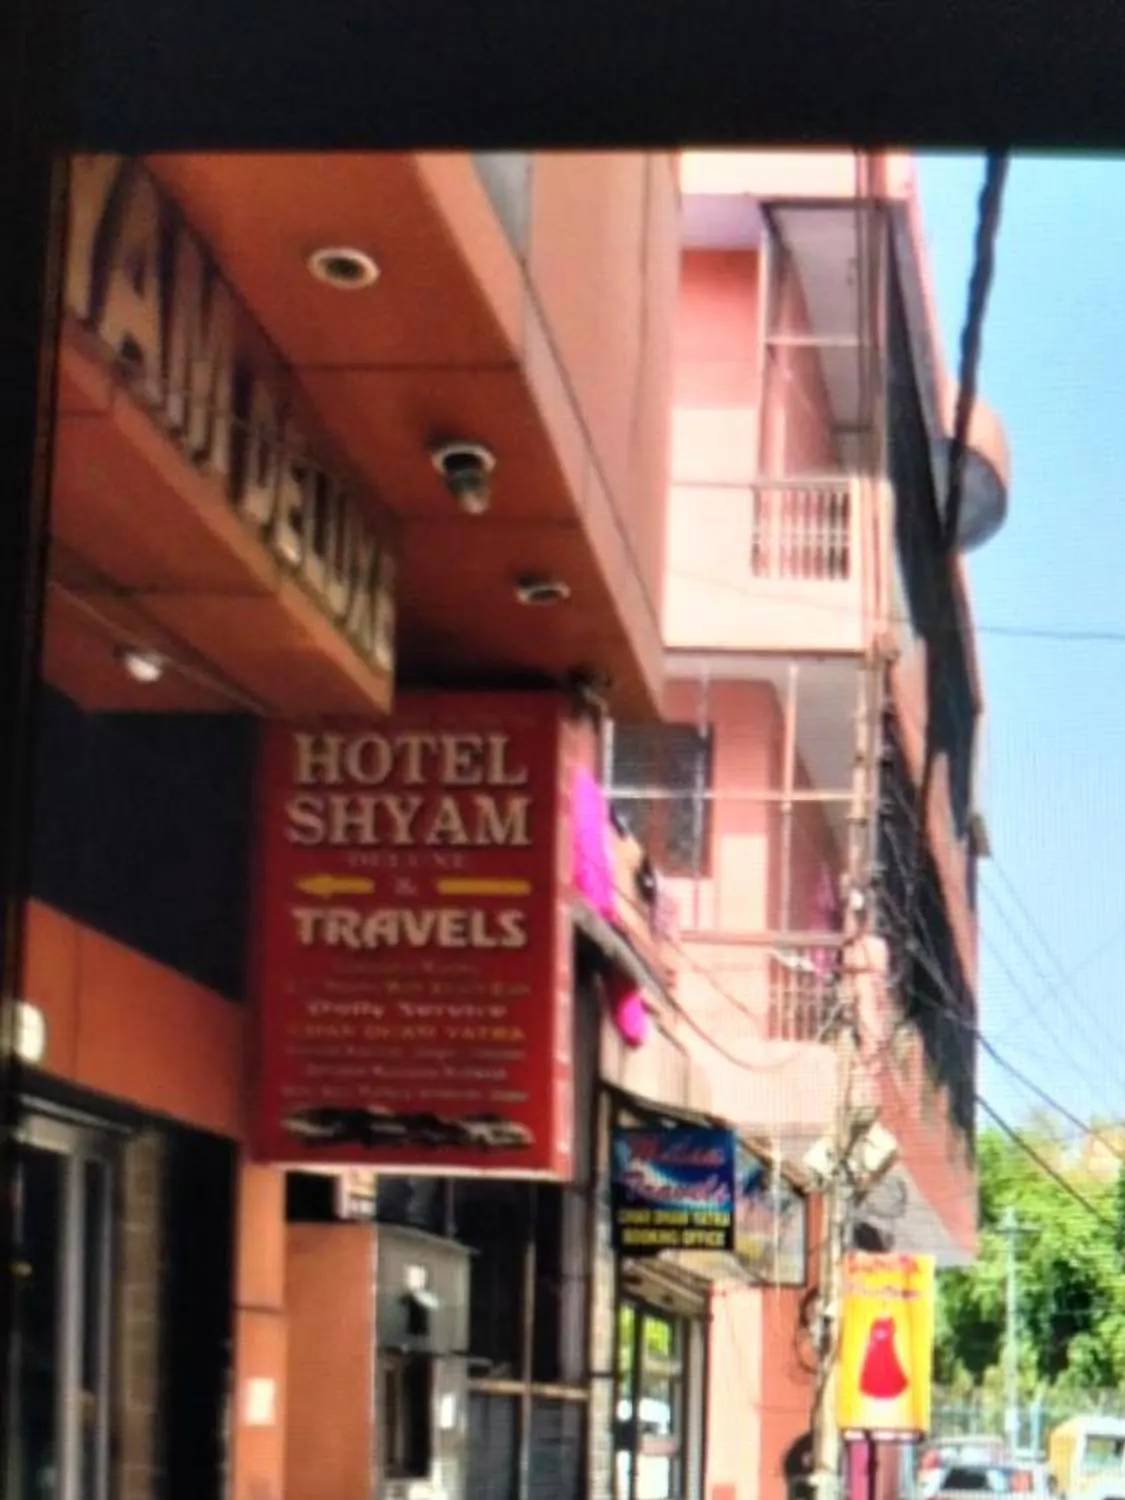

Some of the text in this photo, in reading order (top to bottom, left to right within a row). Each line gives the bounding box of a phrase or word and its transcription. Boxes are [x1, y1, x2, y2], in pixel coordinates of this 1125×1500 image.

[293, 731, 529, 787] HOTEL
[285, 796, 533, 848] SHYAM
[290, 907, 528, 950] TRAVELS
